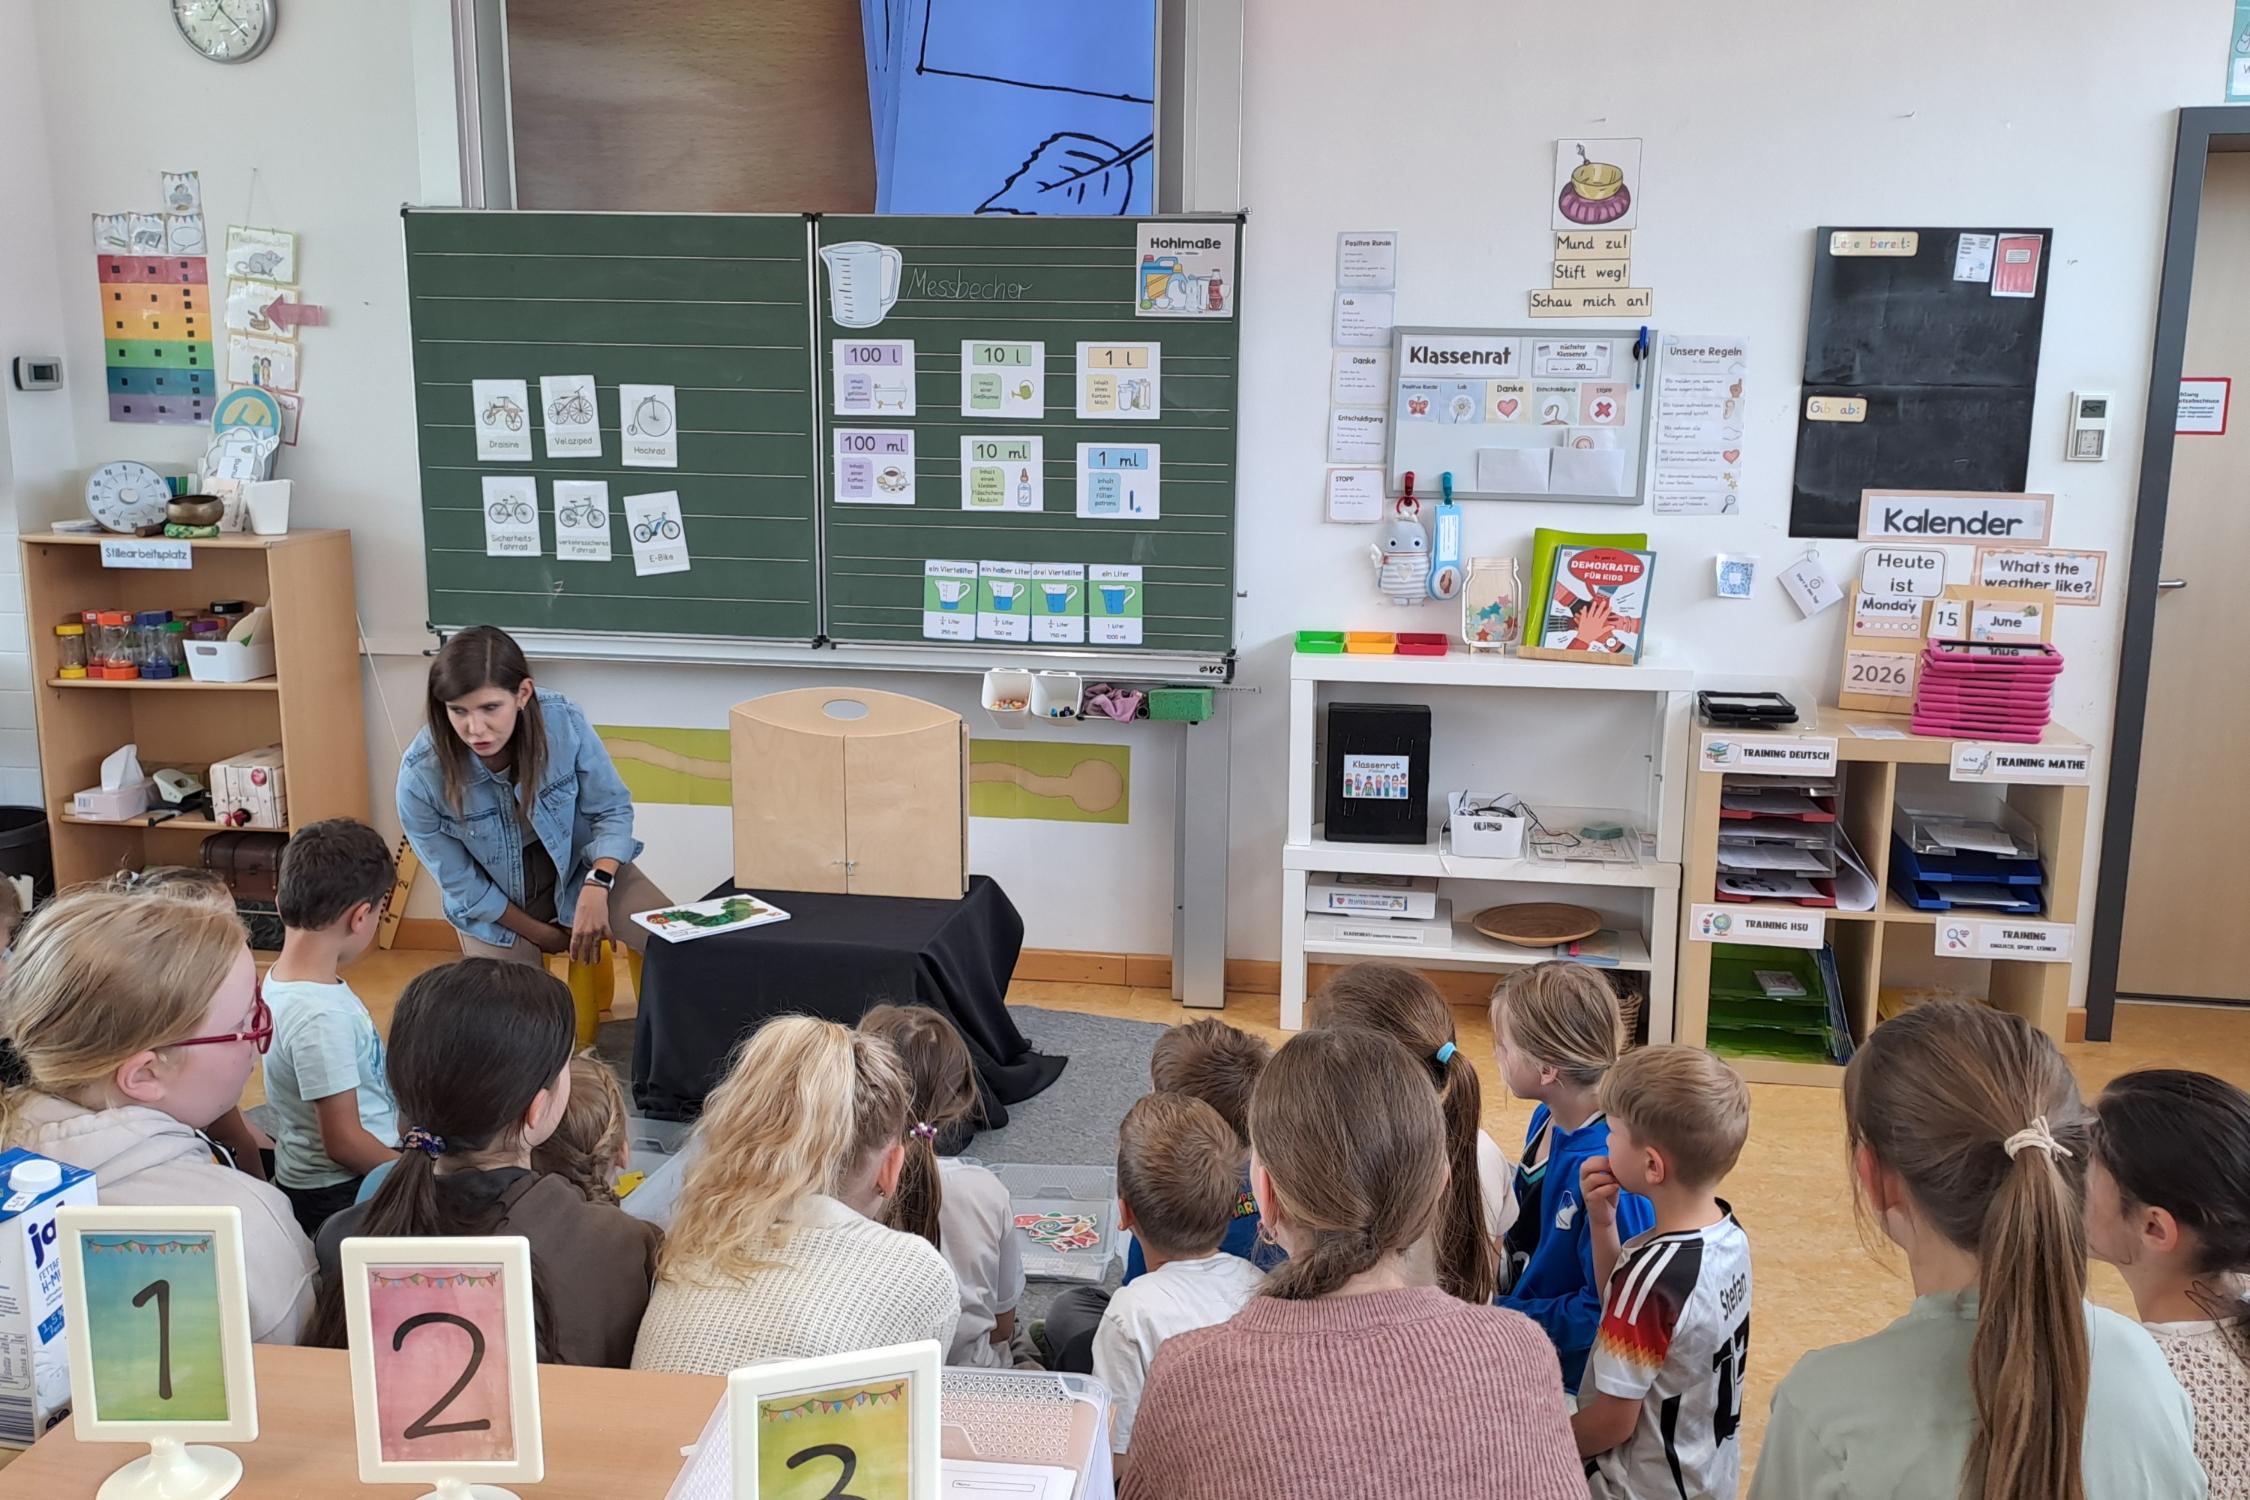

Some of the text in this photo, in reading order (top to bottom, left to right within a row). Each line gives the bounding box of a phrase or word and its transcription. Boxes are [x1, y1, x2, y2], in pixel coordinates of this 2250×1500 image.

[1150, 237, 1222, 249] Hohlmaße
[1556, 234, 1627, 250] Mund zu!
[1833, 235, 1911, 249] Lee beret:
[1554, 264, 1626, 282] Stift weg!
[906, 267, 1033, 300] Messbecher
[1531, 292, 1649, 308] Schau mich an!
[850, 347, 898, 363] 100 l
[984, 347, 1021, 364] 10 l
[1105, 350, 1132, 366] 1 l
[1409, 346, 1512, 365] Klassenrat
[1669, 346, 1743, 358] Unsere Regeln
[1496, 384, 1524, 393] Danke
[1338, 415, 1384, 424] Entschuldigung
[489, 440, 520, 449] Draisine
[633, 446, 666, 456] Hochrad
[844, 435, 906, 452] 100 ml
[976, 443, 1028, 459] 10 ml
[1098, 451, 1139, 467] 1 ml
[1883, 508, 2023, 536] Kalender
[490, 534, 535, 543] Sicherheits-
[105, 547, 188, 561] Stillearbeitsplatz
[649, 553, 674, 563] E-Bike
[1877, 553, 1935, 570] Heute
[1570, 560, 1641, 573] DEMOKRATIE
[1999, 559, 2079, 575] What's the
[1583, 571, 1624, 581] FÜR KIDS
[1890, 577, 1914, 593] ist
[1984, 577, 2093, 594] weather like?
[1861, 597, 1917, 614] Monday
[1937, 611, 1959, 627] 15
[1990, 616, 2022, 629] June
[1851, 664, 1906, 685] 2026
[1743, 748, 1829, 760] TRAINING DEUTSCH
[1352, 760, 1400, 769] Klassenrat
[1996, 756, 2085, 770] TRAINING MATHE
[1745, 919, 1809, 932] TRAINING HSU
[2002, 930, 2047, 941] TRAINING
[28, 1200, 65, 1269] ja
[1719, 1272, 1747, 1321] Stefan
[132, 1279, 173, 1401] 1
[392, 1312, 491, 1440] 2
